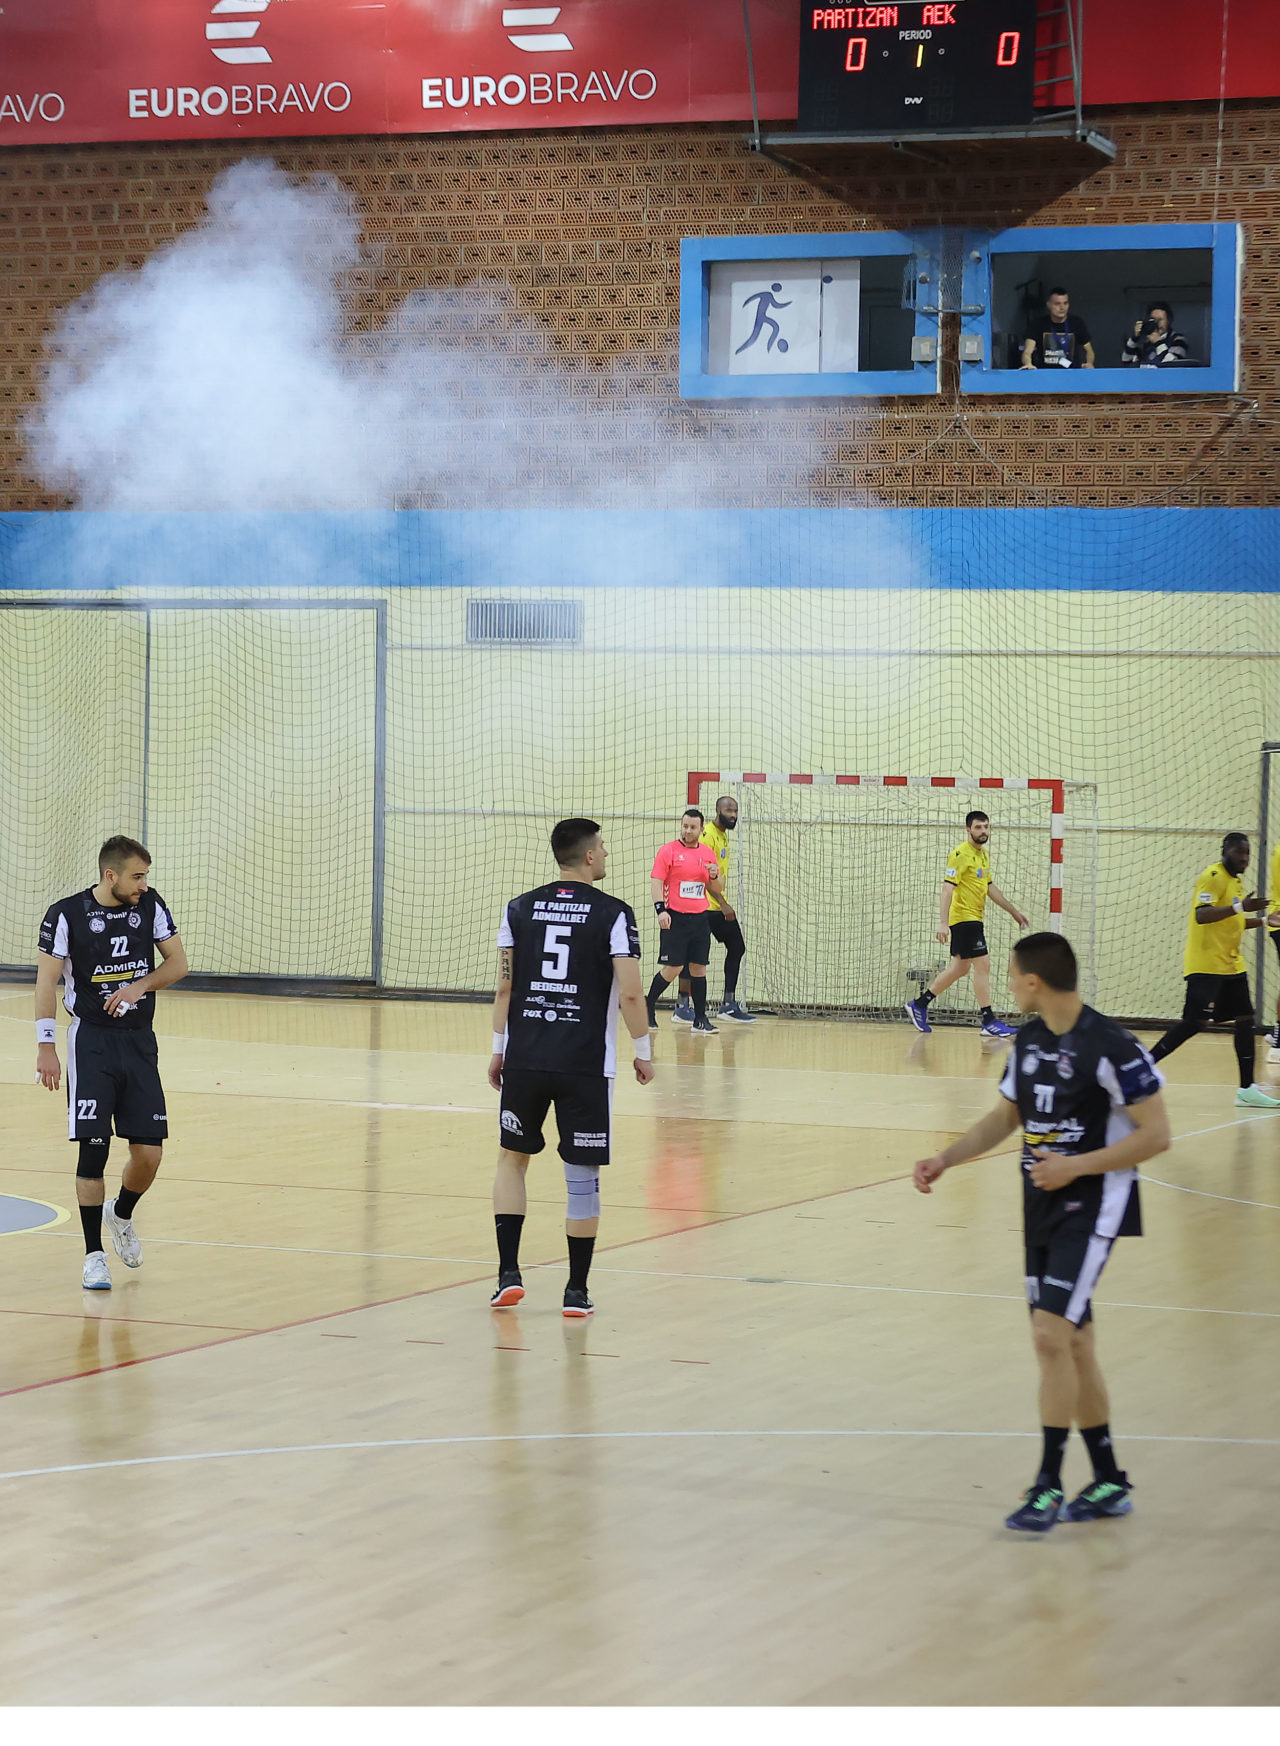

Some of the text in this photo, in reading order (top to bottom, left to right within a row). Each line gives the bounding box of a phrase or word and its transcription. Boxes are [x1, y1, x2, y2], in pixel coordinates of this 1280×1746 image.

[812, 4, 956, 29] PARTIZAN AEK
[899, 30, 932, 40] PERIOD
[845, 31, 1020, 71] 0 1 0
[128, 81, 351, 118] EUROBRAVO
[421, 69, 658, 109] EUROBRAVO
[532, 912, 588, 923] ADMIRALBET
[533, 901, 591, 913] RK PARTIZAN
[110, 935, 130, 958] 22
[541, 924, 572, 980] 5
[93, 957, 149, 975] ADMIRAL
[530, 981, 577, 994] BEOGRAD
[77, 1099, 97, 1120] 22
